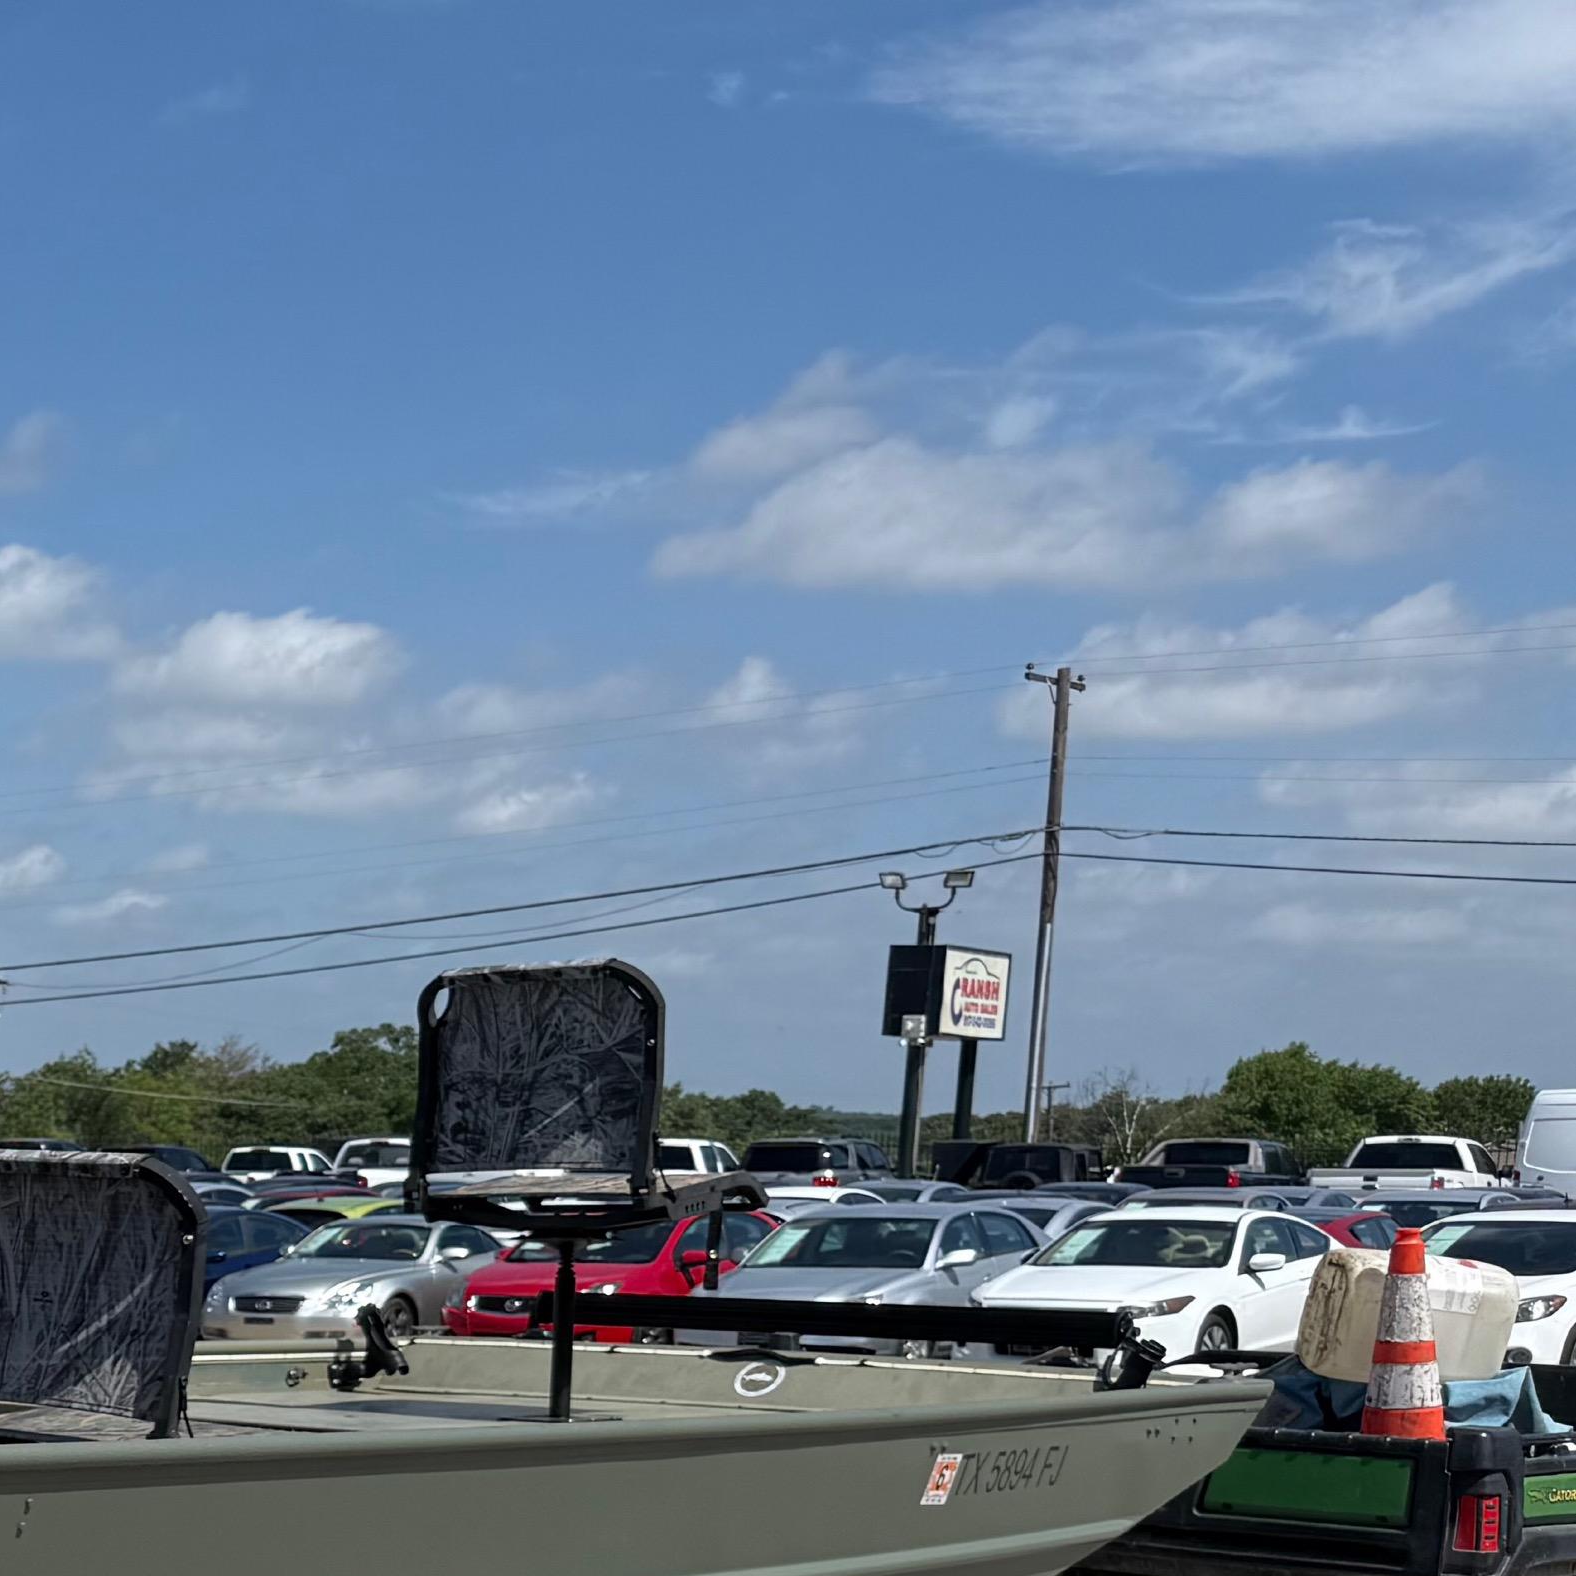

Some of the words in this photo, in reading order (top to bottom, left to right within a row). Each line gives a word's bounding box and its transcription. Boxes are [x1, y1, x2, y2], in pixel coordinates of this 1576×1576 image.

[935, 1464, 949, 1491] 6
[955, 1452, 991, 1495] TX
[985, 1448, 1040, 1493] 5894
[1036, 1445, 1069, 1488] FJ
